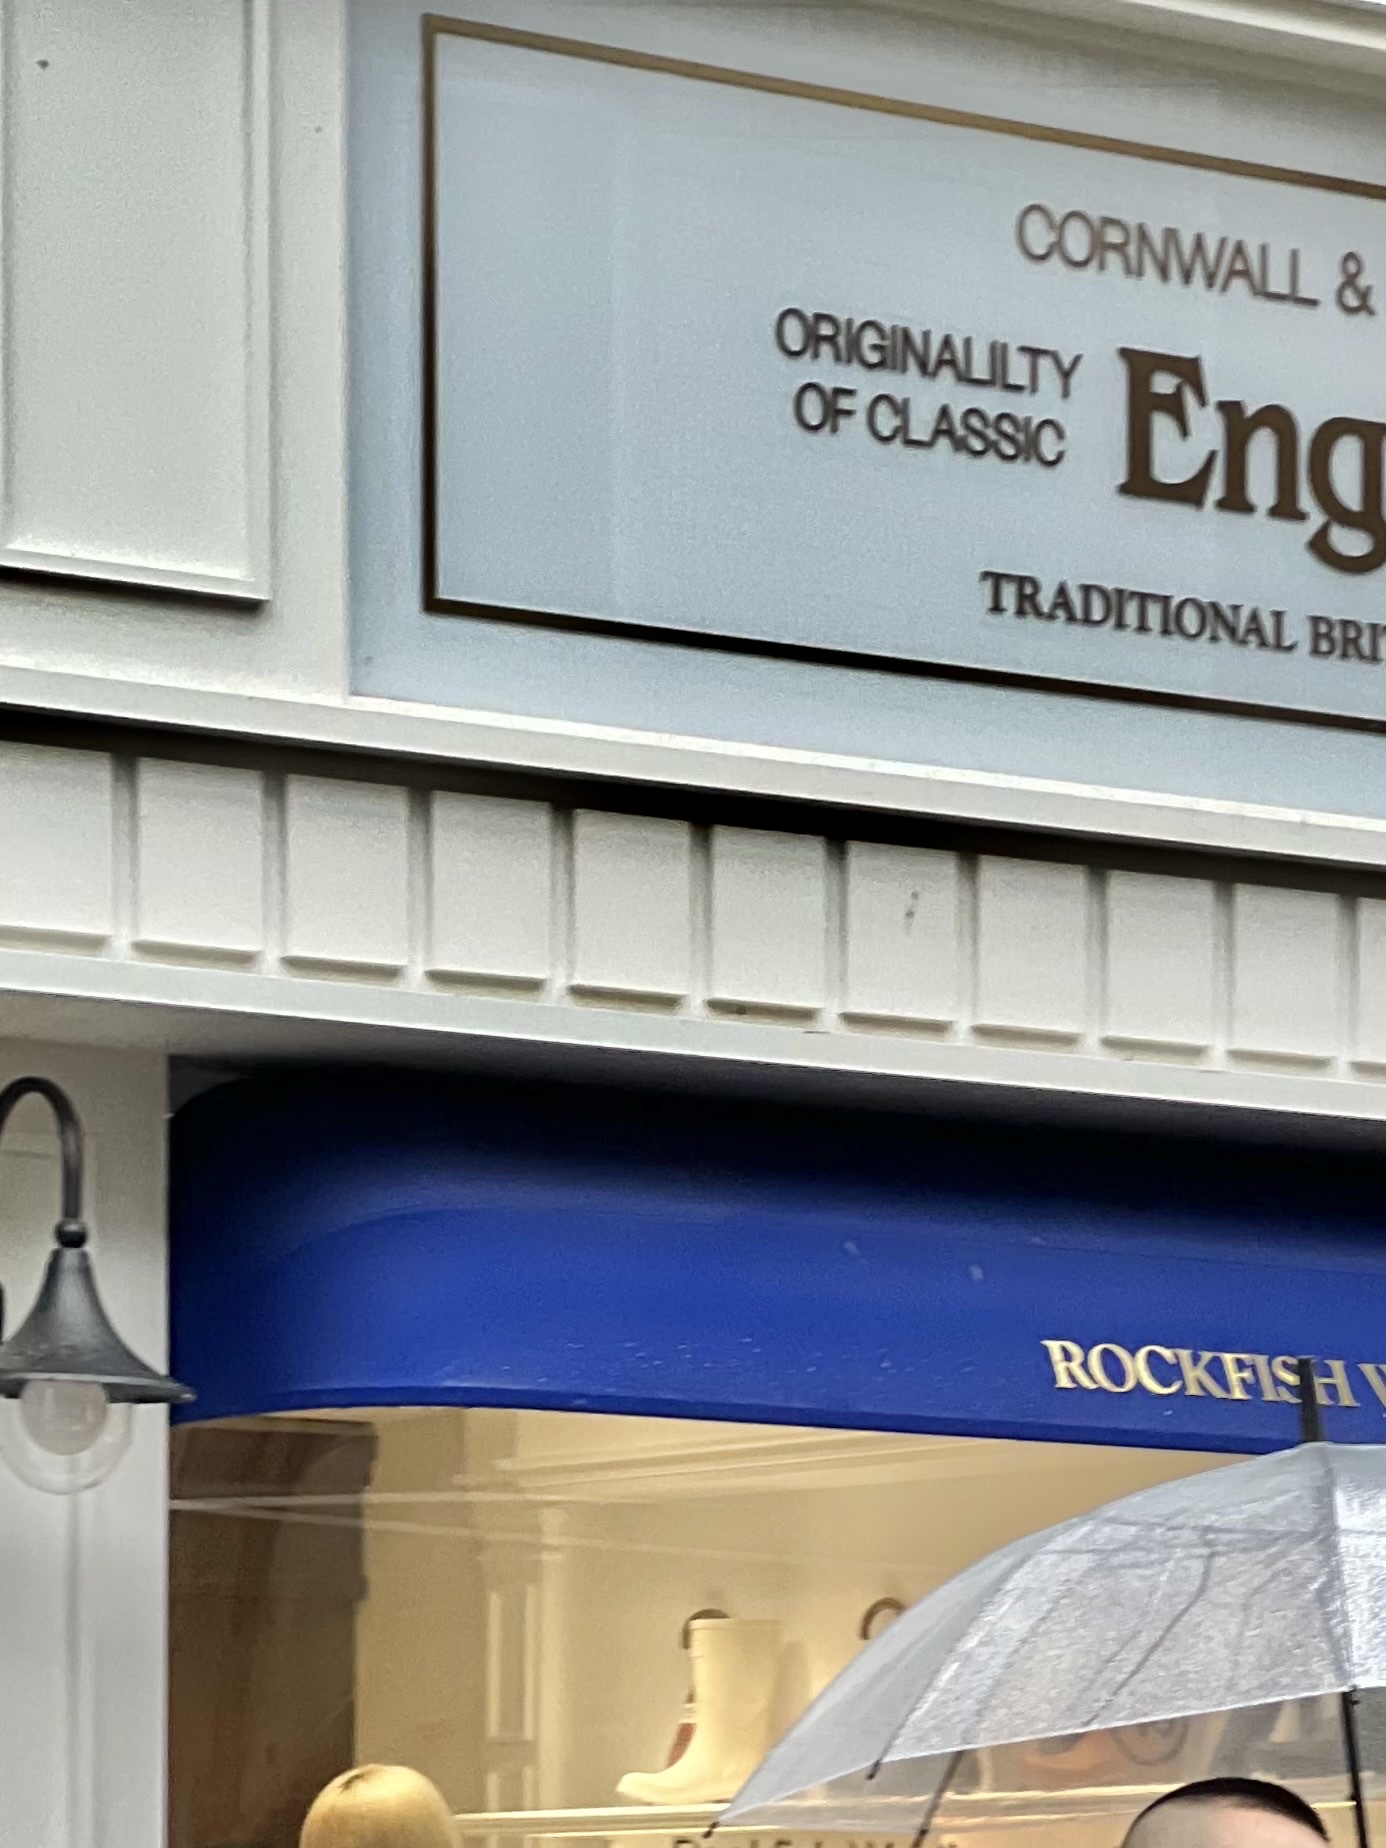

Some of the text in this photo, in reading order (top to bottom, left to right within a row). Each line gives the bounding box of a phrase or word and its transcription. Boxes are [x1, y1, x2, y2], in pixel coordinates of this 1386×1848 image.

[1016, 203, 1320, 307] CORNWALL
[1335, 251, 1375, 318] &
[793, 381, 1065, 467] OF CLASSIC
[979, 570, 1296, 654] TRADITIONAL
[1040, 1339, 1361, 1407] ROCKFISH
